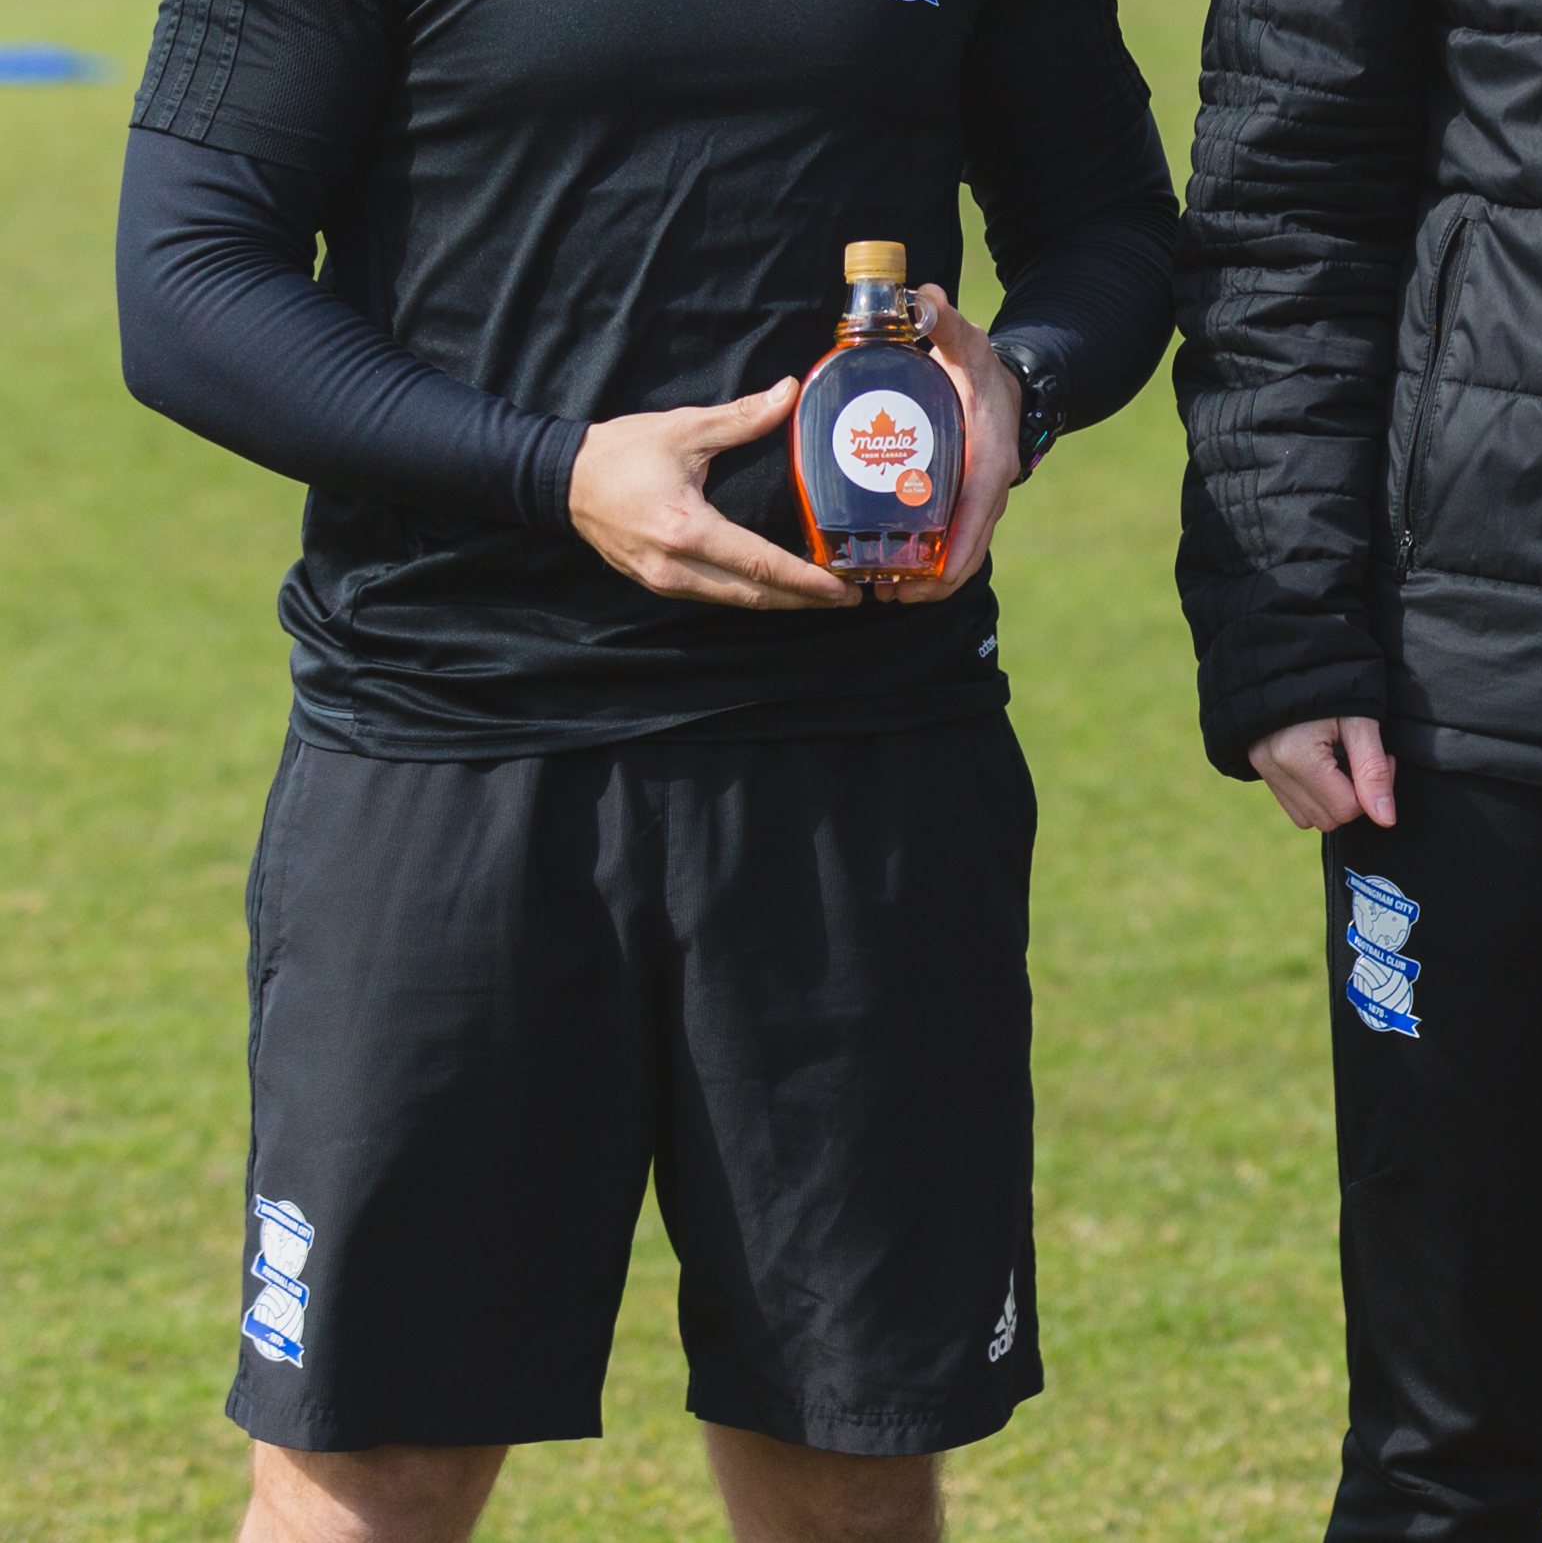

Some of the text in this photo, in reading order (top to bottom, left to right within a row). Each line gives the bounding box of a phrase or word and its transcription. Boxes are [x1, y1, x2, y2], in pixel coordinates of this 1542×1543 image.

[854, 433, 913, 453] maple
[1350, 875, 1415, 916] BIRMINGHAM CITY
[1354, 935, 1407, 972] FOOTBALL CLUB
